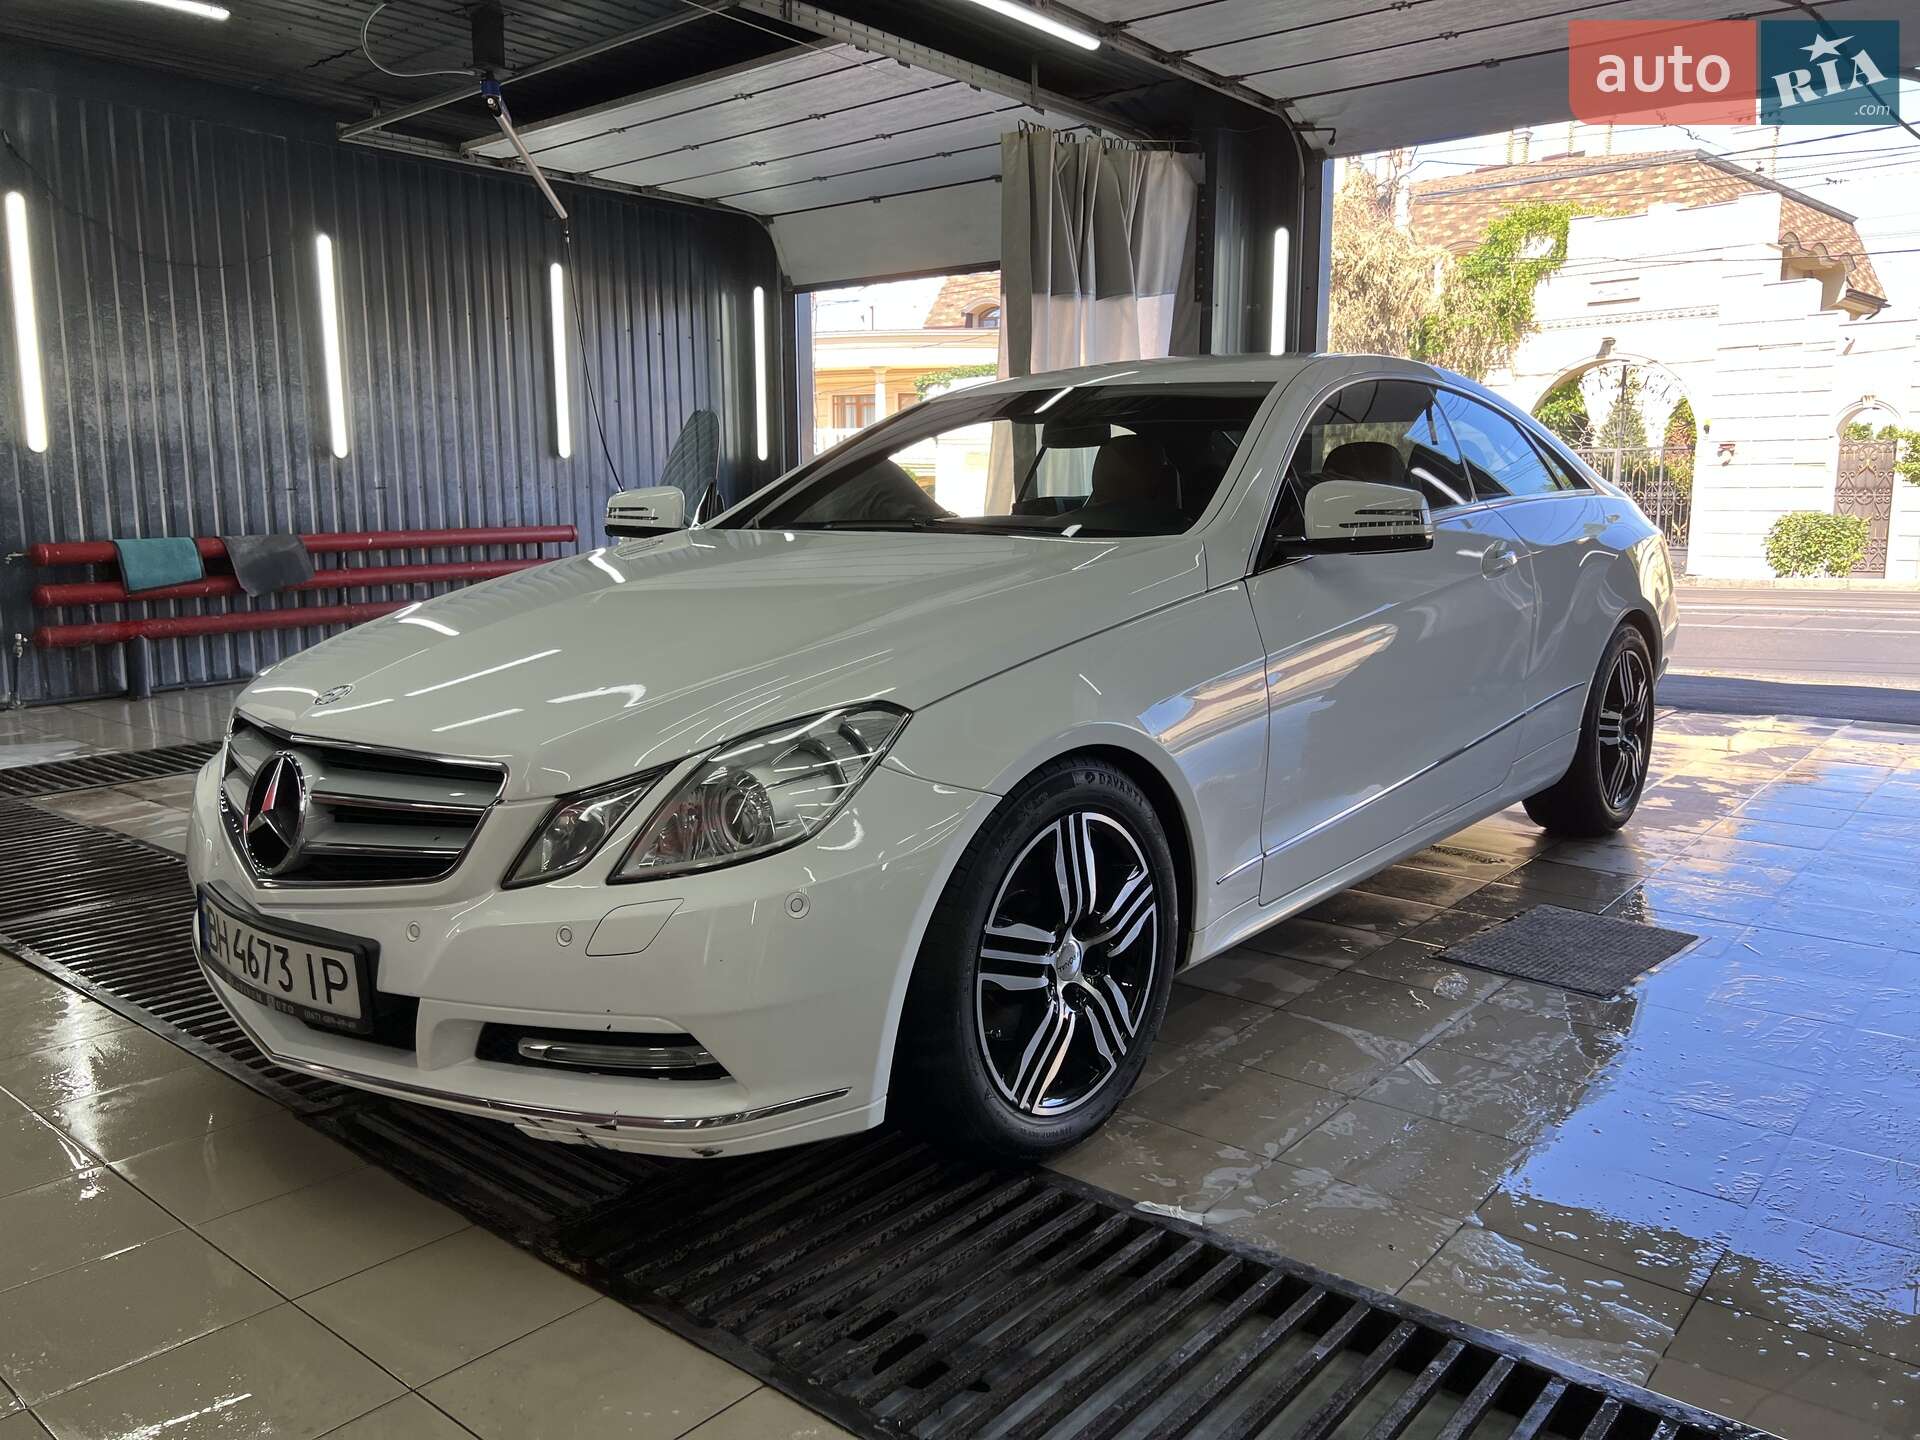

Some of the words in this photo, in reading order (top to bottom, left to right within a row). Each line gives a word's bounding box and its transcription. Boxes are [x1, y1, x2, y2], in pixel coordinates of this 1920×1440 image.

[207, 904, 231, 965] BH
[233, 928, 293, 993] 4673
[306, 953, 348, 1004] IP
